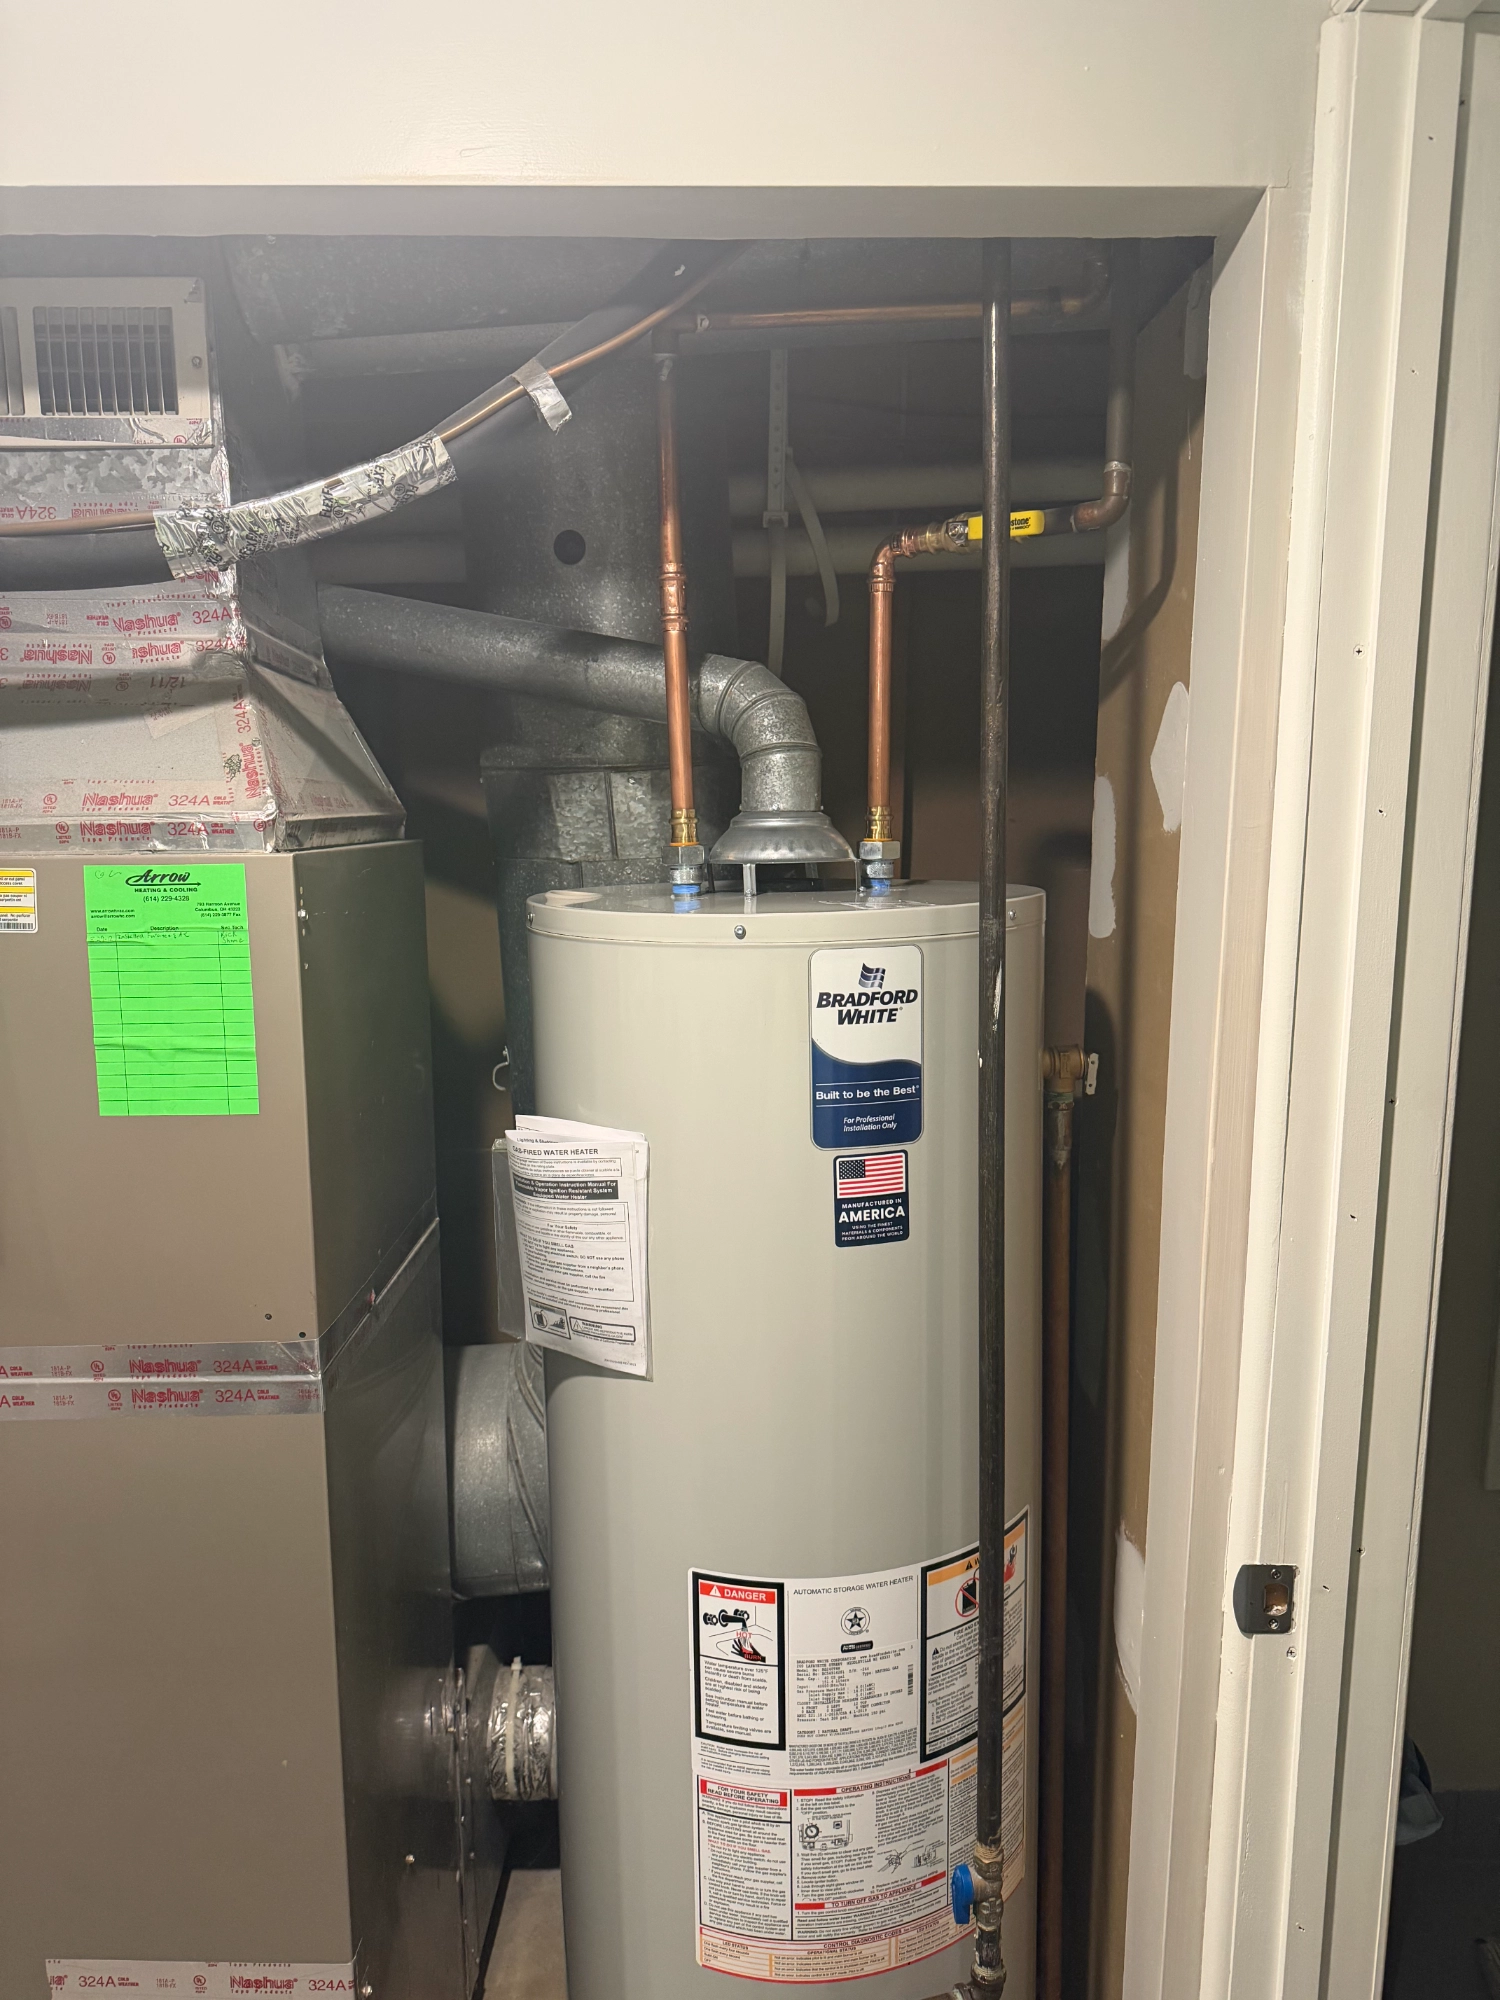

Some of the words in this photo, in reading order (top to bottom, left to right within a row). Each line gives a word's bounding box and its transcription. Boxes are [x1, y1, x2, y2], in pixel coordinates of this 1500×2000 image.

[16, 506, 57, 520] 324A
[1010, 517, 1030, 527] stone
[192, 607, 232, 624] 324A
[23, 649, 93, 665] Nashua
[22, 679, 91, 692] Nashua
[150, 676, 186, 689] 12/11
[233, 699, 252, 734] 324A
[241, 744, 261, 799] Nashua
[82, 792, 154, 807] Nashua
[168, 794, 210, 807] 324A
[80, 821, 152, 836] Nashua
[168, 822, 209, 836] 324A
[126, 869, 190, 885] Arrow
[143, 895, 159, 903] (614)
[816, 989, 919, 1009] BRADFORD
[837, 1008, 899, 1026] WHITE
[816, 1090, 840, 1100] Built
[843, 1090, 854, 1099] to
[856, 1088, 871, 1098] be
[873, 1087, 891, 1097] the
[893, 1085, 916, 1096] Best
[843, 1123, 881, 1132] Installation
[881, 1121, 898, 1131] Only
[855, 1114, 896, 1124] Professional
[543, 1148, 569, 1156] WATER
[570, 1148, 599, 1156] HEATER
[842, 1199, 894, 1209] MANUFACTURED
[838, 1205, 906, 1223] AMERICA
[129, 1359, 198, 1373] Nashua
[212, 1359, 254, 1373] 324A
[131, 1388, 200, 1403] Nashua
[215, 1389, 256, 1403] 324A
[793, 1587, 832, 1595] AUTOMATIC
[833, 1584, 865, 1594] STORAGE
[865, 1580, 889, 1590] WATER
[889, 1575, 914, 1586] HEATER
[724, 1589, 766, 1602] DANGER
[736, 1631, 753, 1639] HOT
[953, 1628, 965, 1637] FIRE
[841, 1784, 873, 1793] OPERATING
[873, 1774, 911, 1788] INSTRUCTIONS
[707, 1788, 723, 1796] READ
[723, 1790, 745, 1800] BEFORE
[746, 1796, 779, 1804] OPERATING
[746, 1790, 769, 1798] SAFETY
[888, 1884, 917, 1898] APPLIANCE
[823, 1941, 850, 1949] CONTROL
[851, 1935, 884, 1946] DIAGNOSTIC
[884, 1929, 902, 1939] CODES
[78, 1975, 116, 1988] 324A
[230, 1975, 295, 1989] Nashua
[308, 1979, 347, 1991] 324A
